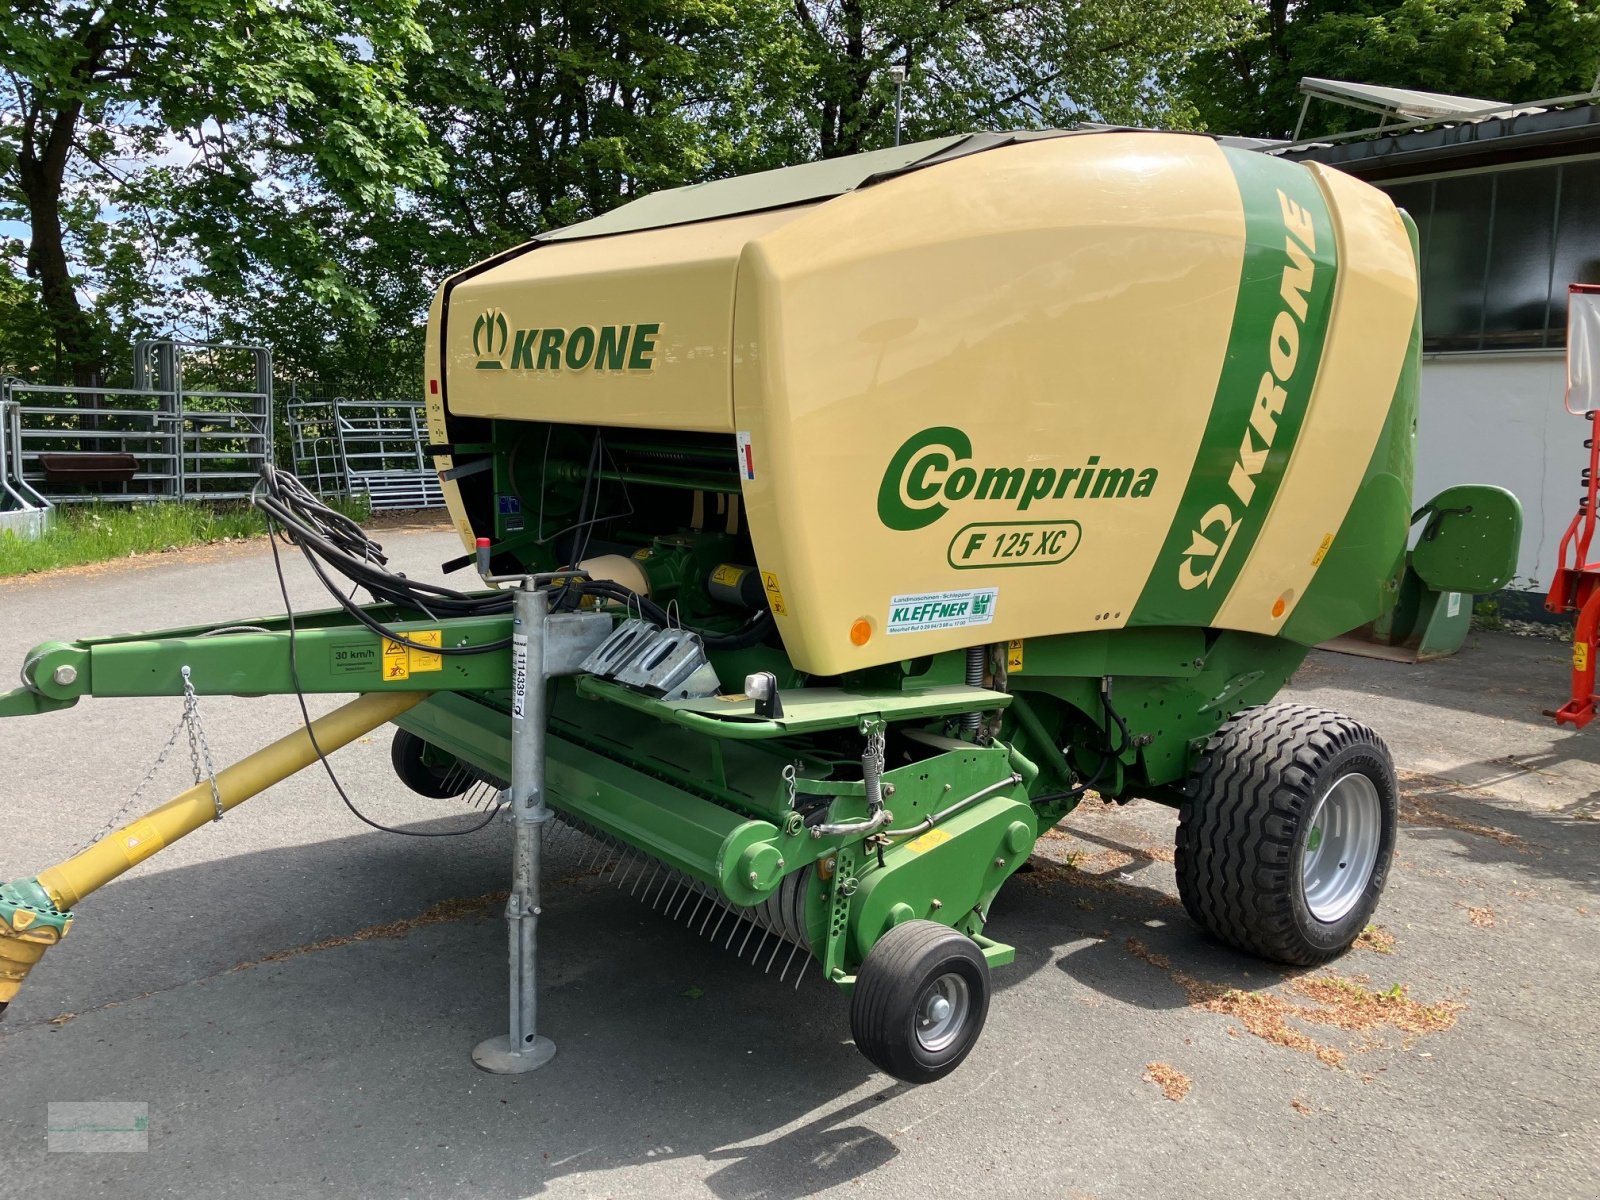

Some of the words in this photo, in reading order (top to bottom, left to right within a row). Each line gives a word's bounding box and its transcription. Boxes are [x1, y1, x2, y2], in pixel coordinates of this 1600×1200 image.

[510, 323, 661, 370] KRONE
[1228, 188, 1316, 508] KRONE
[906, 452, 1159, 511] Comprima
[962, 533, 987, 560] F
[992, 532, 1034, 558] 125
[1032, 530, 1068, 556] XC
[892, 602, 969, 622] KLEFFNER
[335, 651, 347, 660] 30
[350, 649, 375, 659] km/h
[516, 652, 527, 697] 1114339
